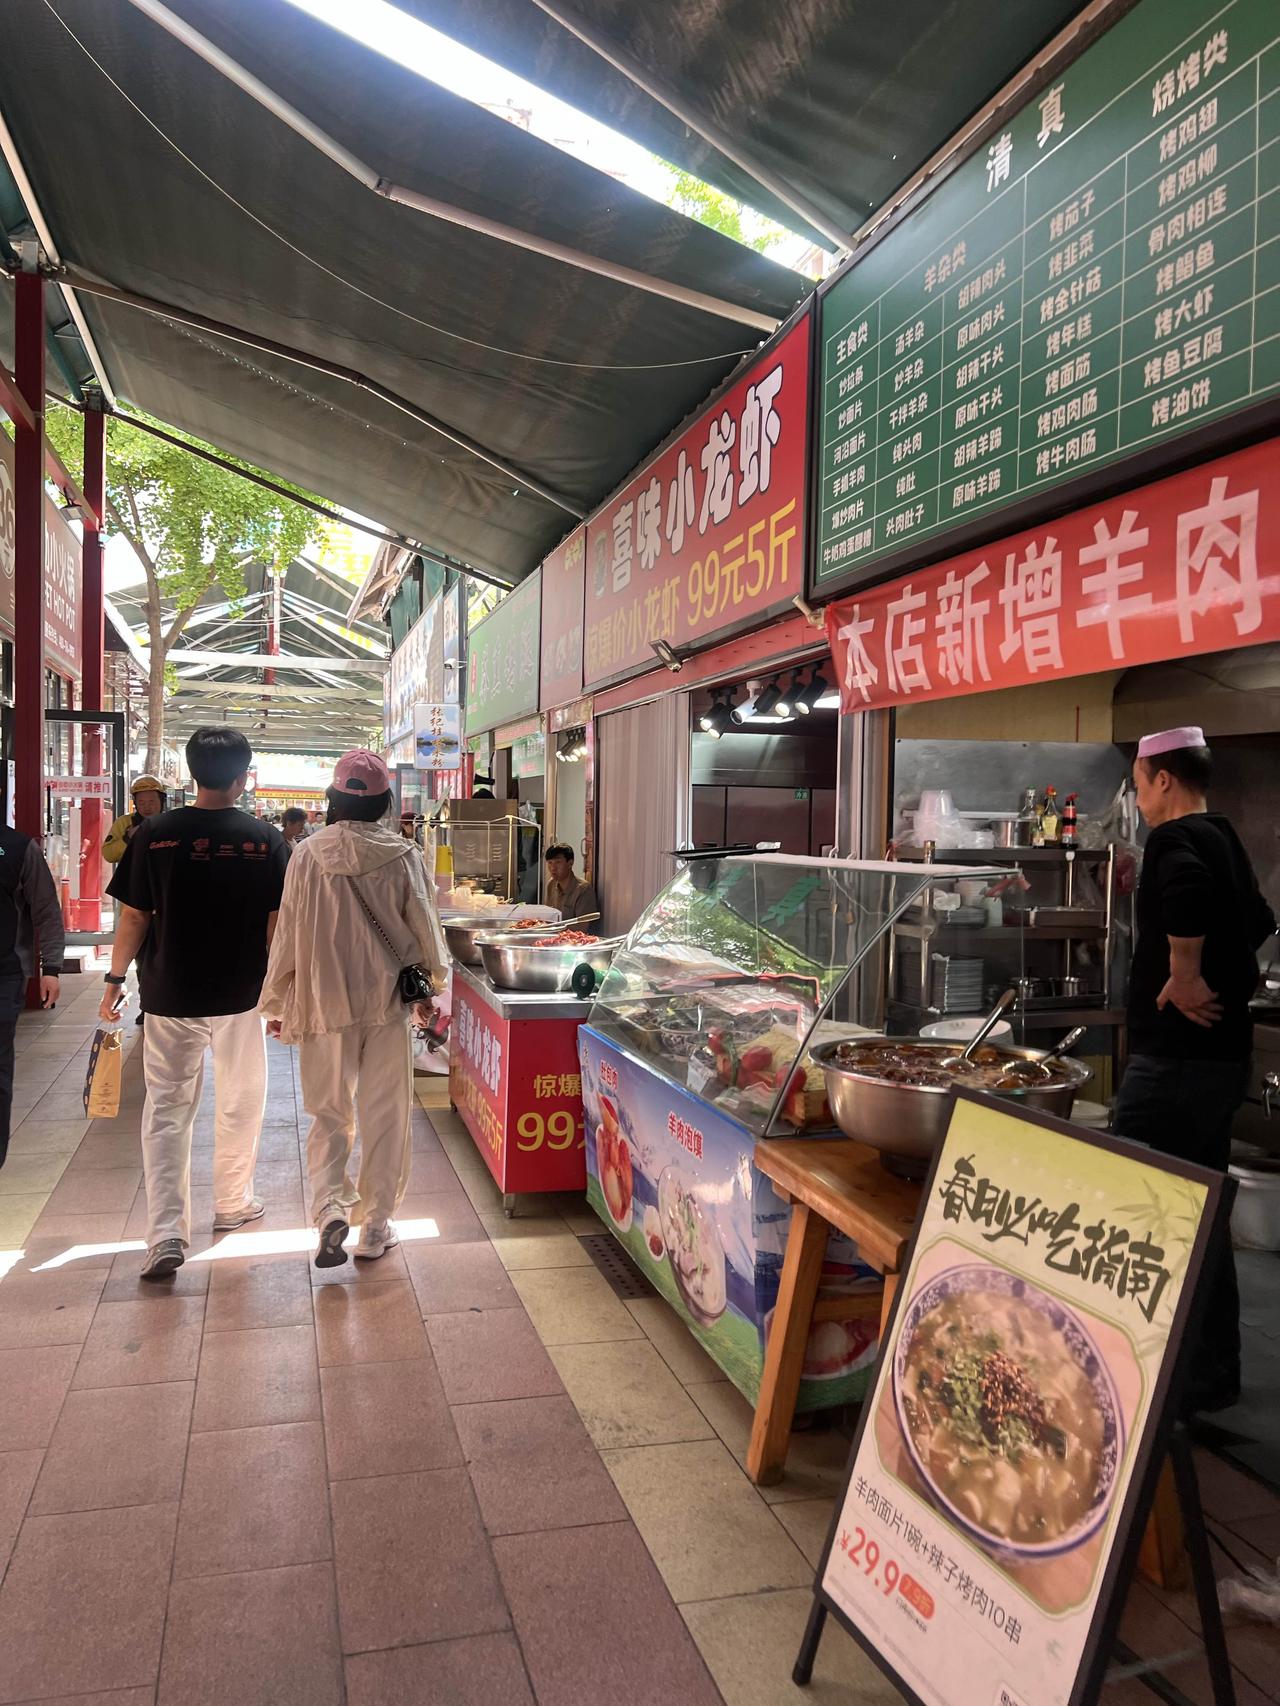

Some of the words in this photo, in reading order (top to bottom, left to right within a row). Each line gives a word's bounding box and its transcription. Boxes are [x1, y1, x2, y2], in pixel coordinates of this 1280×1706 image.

[1152, 29, 1228, 118] 烧烤类
[985, 82, 1065, 193] 清真
[1159, 97, 1218, 164] 烤鸡翅
[1158, 143, 1218, 208] 烤鸡柳
[1050, 189, 1095, 241] 烤茄子
[1149, 184, 1227, 256] 骨肉相连
[924, 240, 966, 293] 羊杂类
[1049, 229, 1095, 281] 烤韭菜
[958, 258, 1006, 310] 胡辣肉头
[1040, 266, 1102, 325] 烤金针菇
[957, 301, 1006, 351] 原味肉头
[1046, 312, 1092, 359] 烤年糕
[1154, 284, 1214, 340] 烤大虾
[836, 320, 868, 365] 主食类
[956, 342, 1004, 390] 胡辣干头
[1144, 325, 1224, 388] 烤鱼豆腐
[839, 365, 864, 398] 炒拉条
[894, 358, 924, 393] 炒羊杂
[1045, 352, 1091, 397] 烤面筋
[838, 399, 863, 431] 炒面片
[889, 391, 928, 430] 干拌羊杂
[955, 384, 1003, 430] 原味干头
[1037, 387, 1098, 438] 烤鸡肉肠
[1152, 377, 1211, 428] 烤油饼
[954, 426, 1002, 468] 胡辣羊蹄
[1036, 428, 1096, 476] 烤牛肉肠
[610, 364, 784, 594] 喜味小龙虾
[832, 464, 866, 498] 手抓羊肉
[952, 468, 1001, 509] 原味羊蹄
[885, 503, 925, 538] 头肉肚子
[687, 497, 797, 626] 99元5斤
[837, 476, 1263, 703] 本店新增羊肉
[459, 999, 502, 1097] 喜味小龙虾
[668, 1111, 703, 1160] 羊肉泡馍
[939, 1153, 1172, 1324] 春日必吃指南
[854, 1475, 1023, 1645] 羊肉面片1碗+辣子烤肉10串
